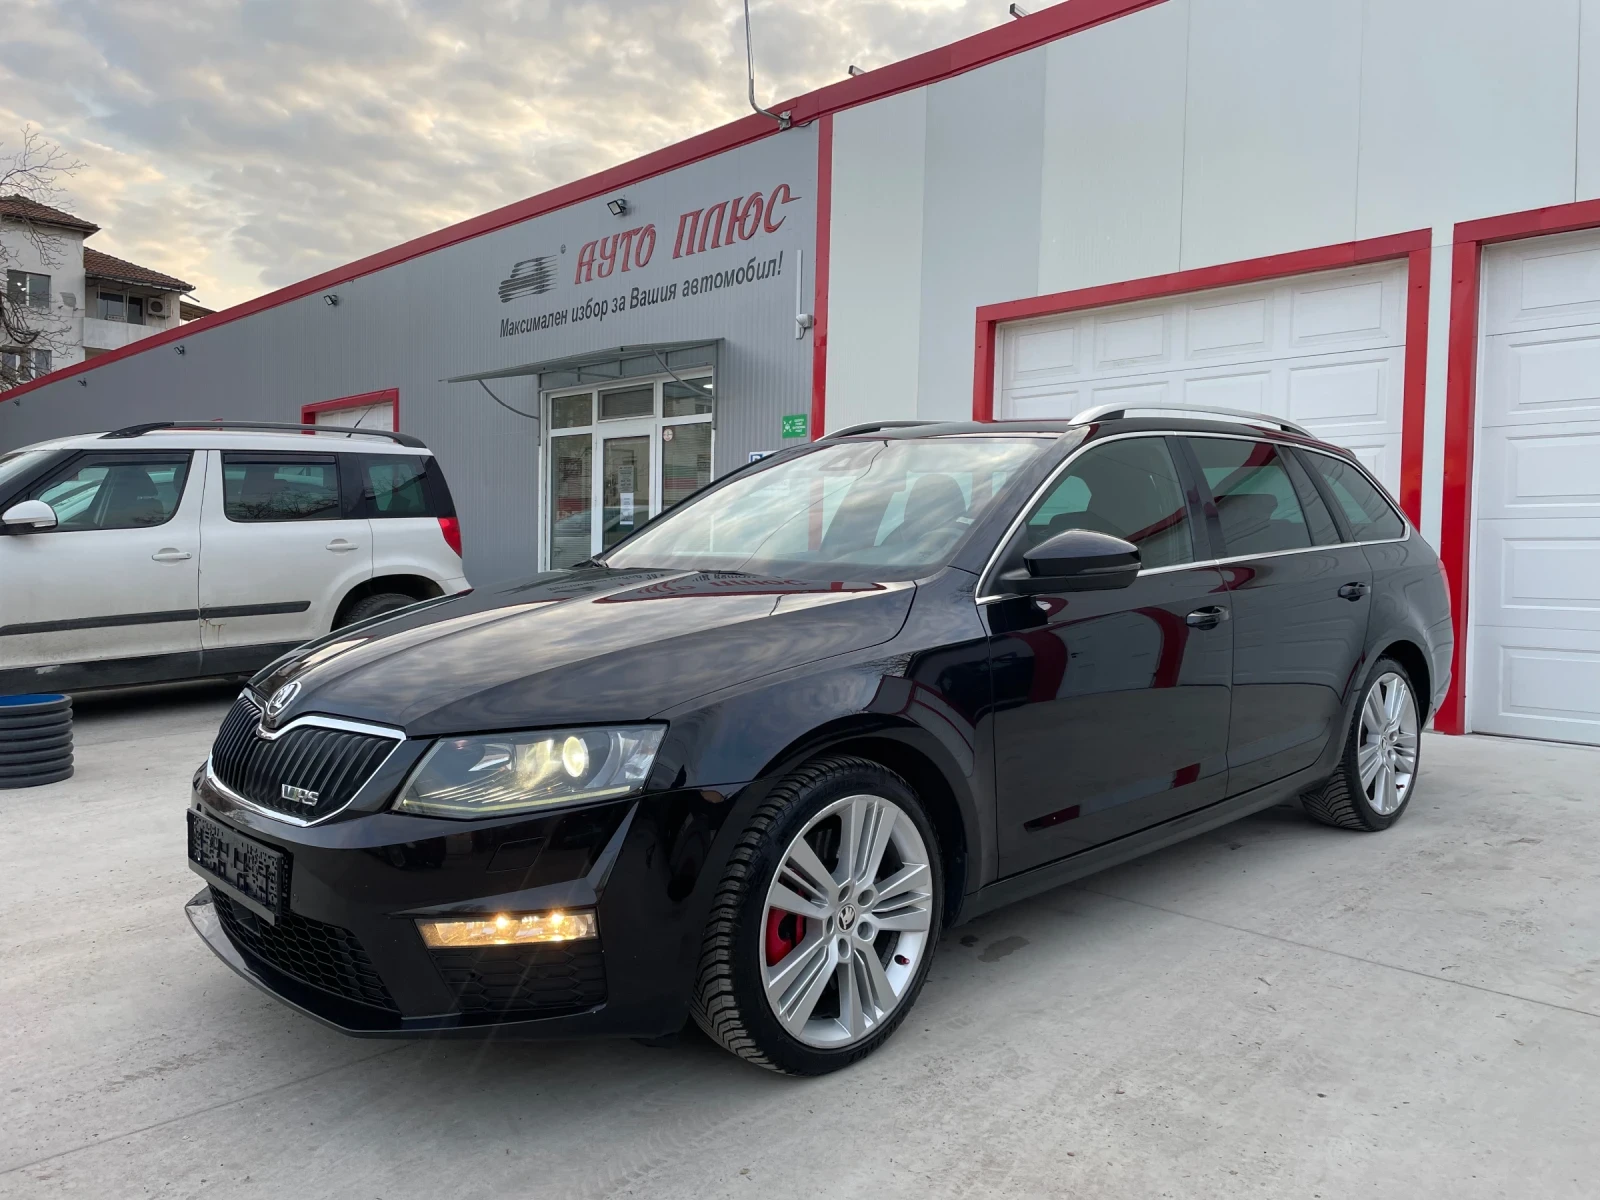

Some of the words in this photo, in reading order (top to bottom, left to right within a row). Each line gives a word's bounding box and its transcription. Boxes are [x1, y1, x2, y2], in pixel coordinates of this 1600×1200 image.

[574, 223, 656, 285] АУТО
[672, 183, 803, 260] ПЛЮС
[500, 308, 568, 338] Максимален
[571, 296, 608, 321] избор
[611, 295, 626, 314] за
[629, 283, 677, 310] Вашия
[682, 250, 784, 297] автомобил!
